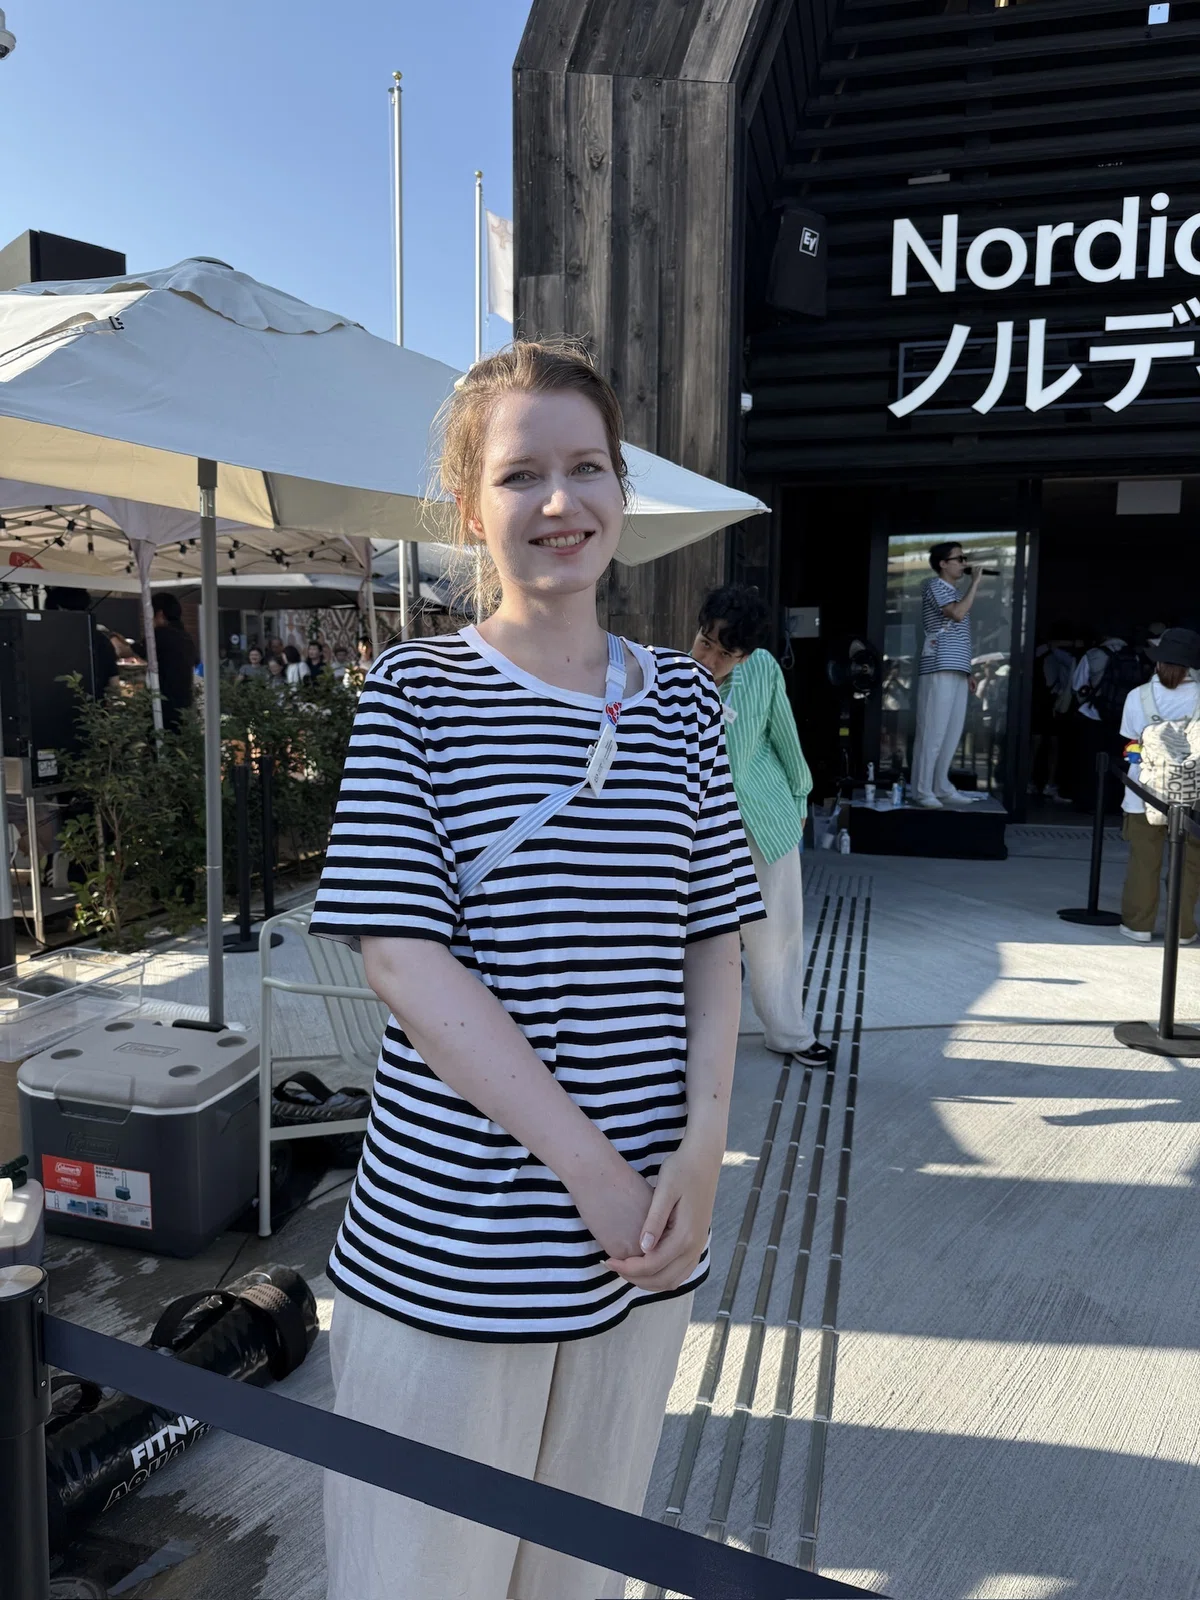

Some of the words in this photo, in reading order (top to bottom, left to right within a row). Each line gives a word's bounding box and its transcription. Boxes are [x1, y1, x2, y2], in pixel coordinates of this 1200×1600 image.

[887, 297, 1200, 418] ノルデ
[1168, 764, 1183, 800] FACE
